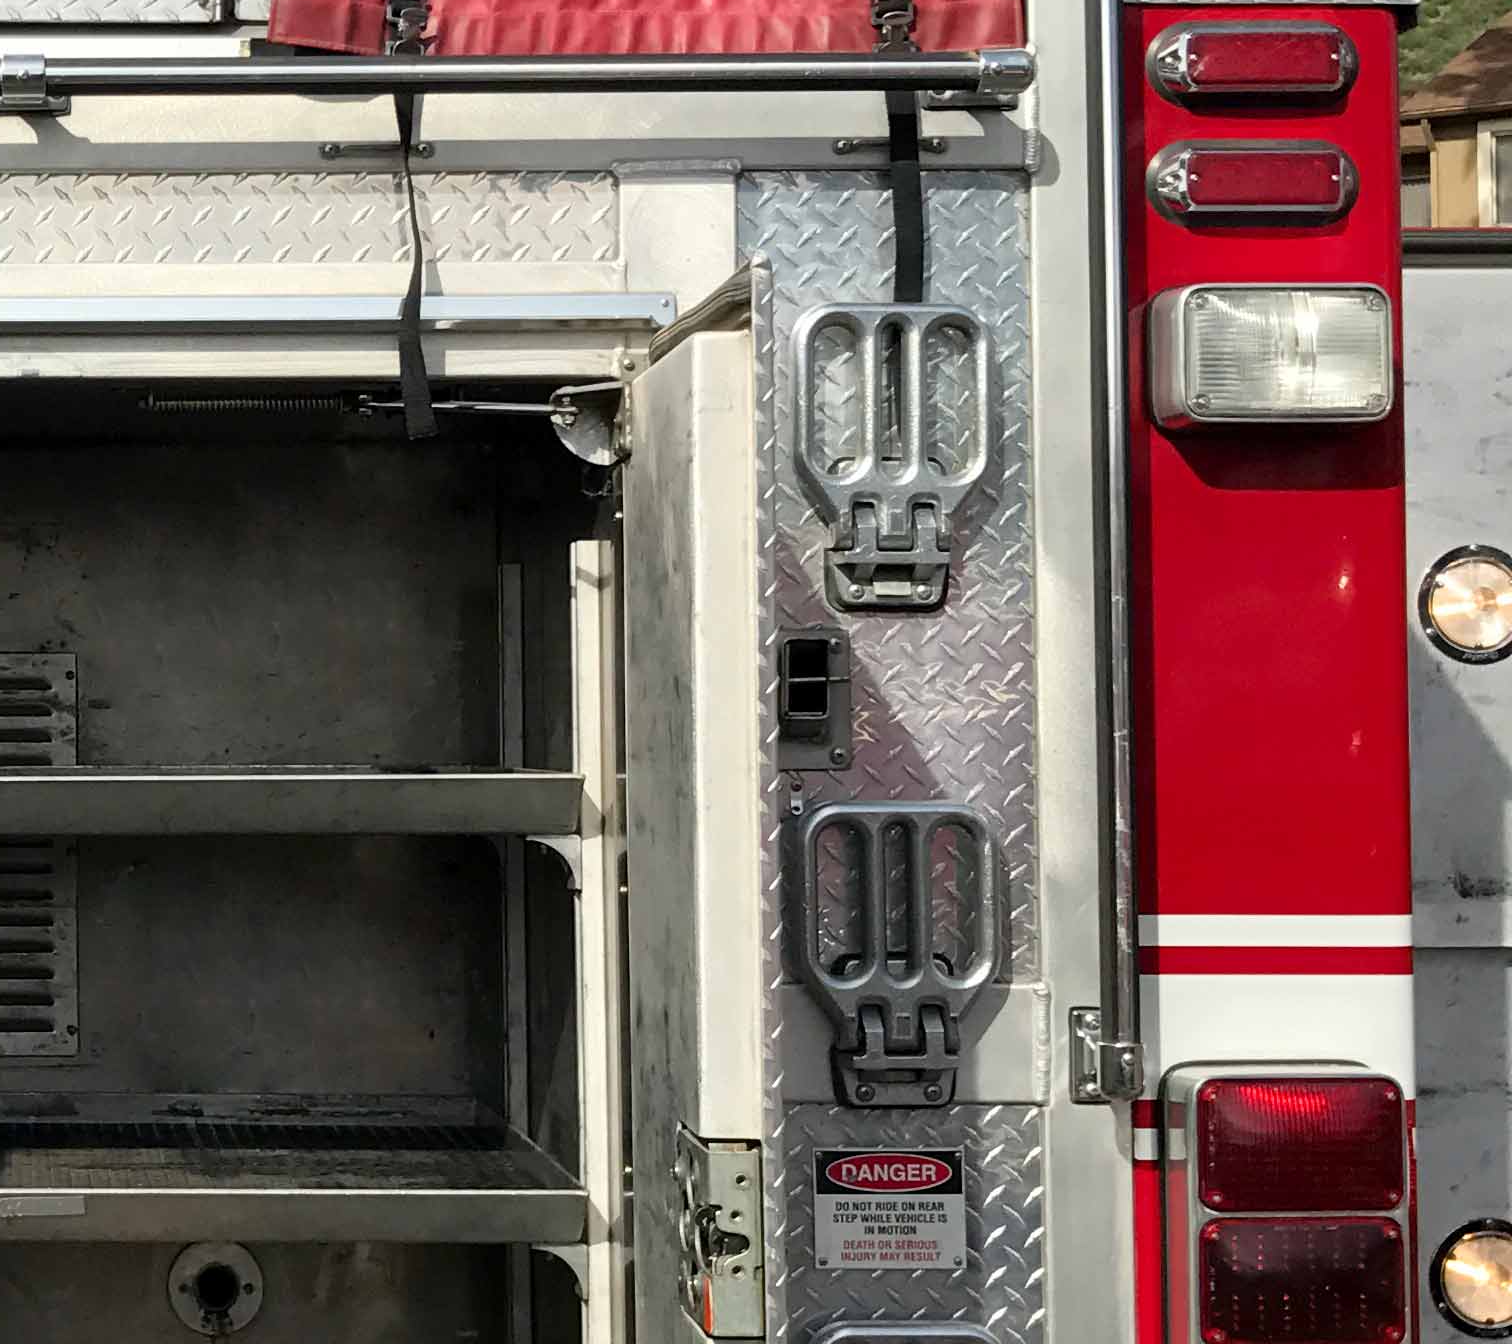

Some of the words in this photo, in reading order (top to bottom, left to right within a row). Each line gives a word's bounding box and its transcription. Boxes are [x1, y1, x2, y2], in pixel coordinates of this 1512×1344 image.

[841, 1164, 937, 1181] DANGER
[835, 1202, 849, 1211] DO
[852, 1202, 872, 1211] NOT
[875, 1202, 898, 1211] RIDE
[901, 1202, 915, 1211] ON
[918, 1202, 945, 1211] REAR
[832, 1214, 858, 1223] STEP
[861, 1214, 892, 1223] WHILE
[895, 1214, 935, 1223] VEHICLE
[938, 1214, 947, 1223] IS
[864, 1226, 874, 1235] IN
[878, 1226, 917, 1235] MOTION
[843, 1240, 875, 1249] DEATH
[878, 1240, 892, 1249] OR
[895, 1240, 937, 1249] SERIOUS
[841, 1252, 876, 1261] INJURY
[879, 1252, 900, 1261] MAY
[904, 1252, 941, 1261] RESULT
